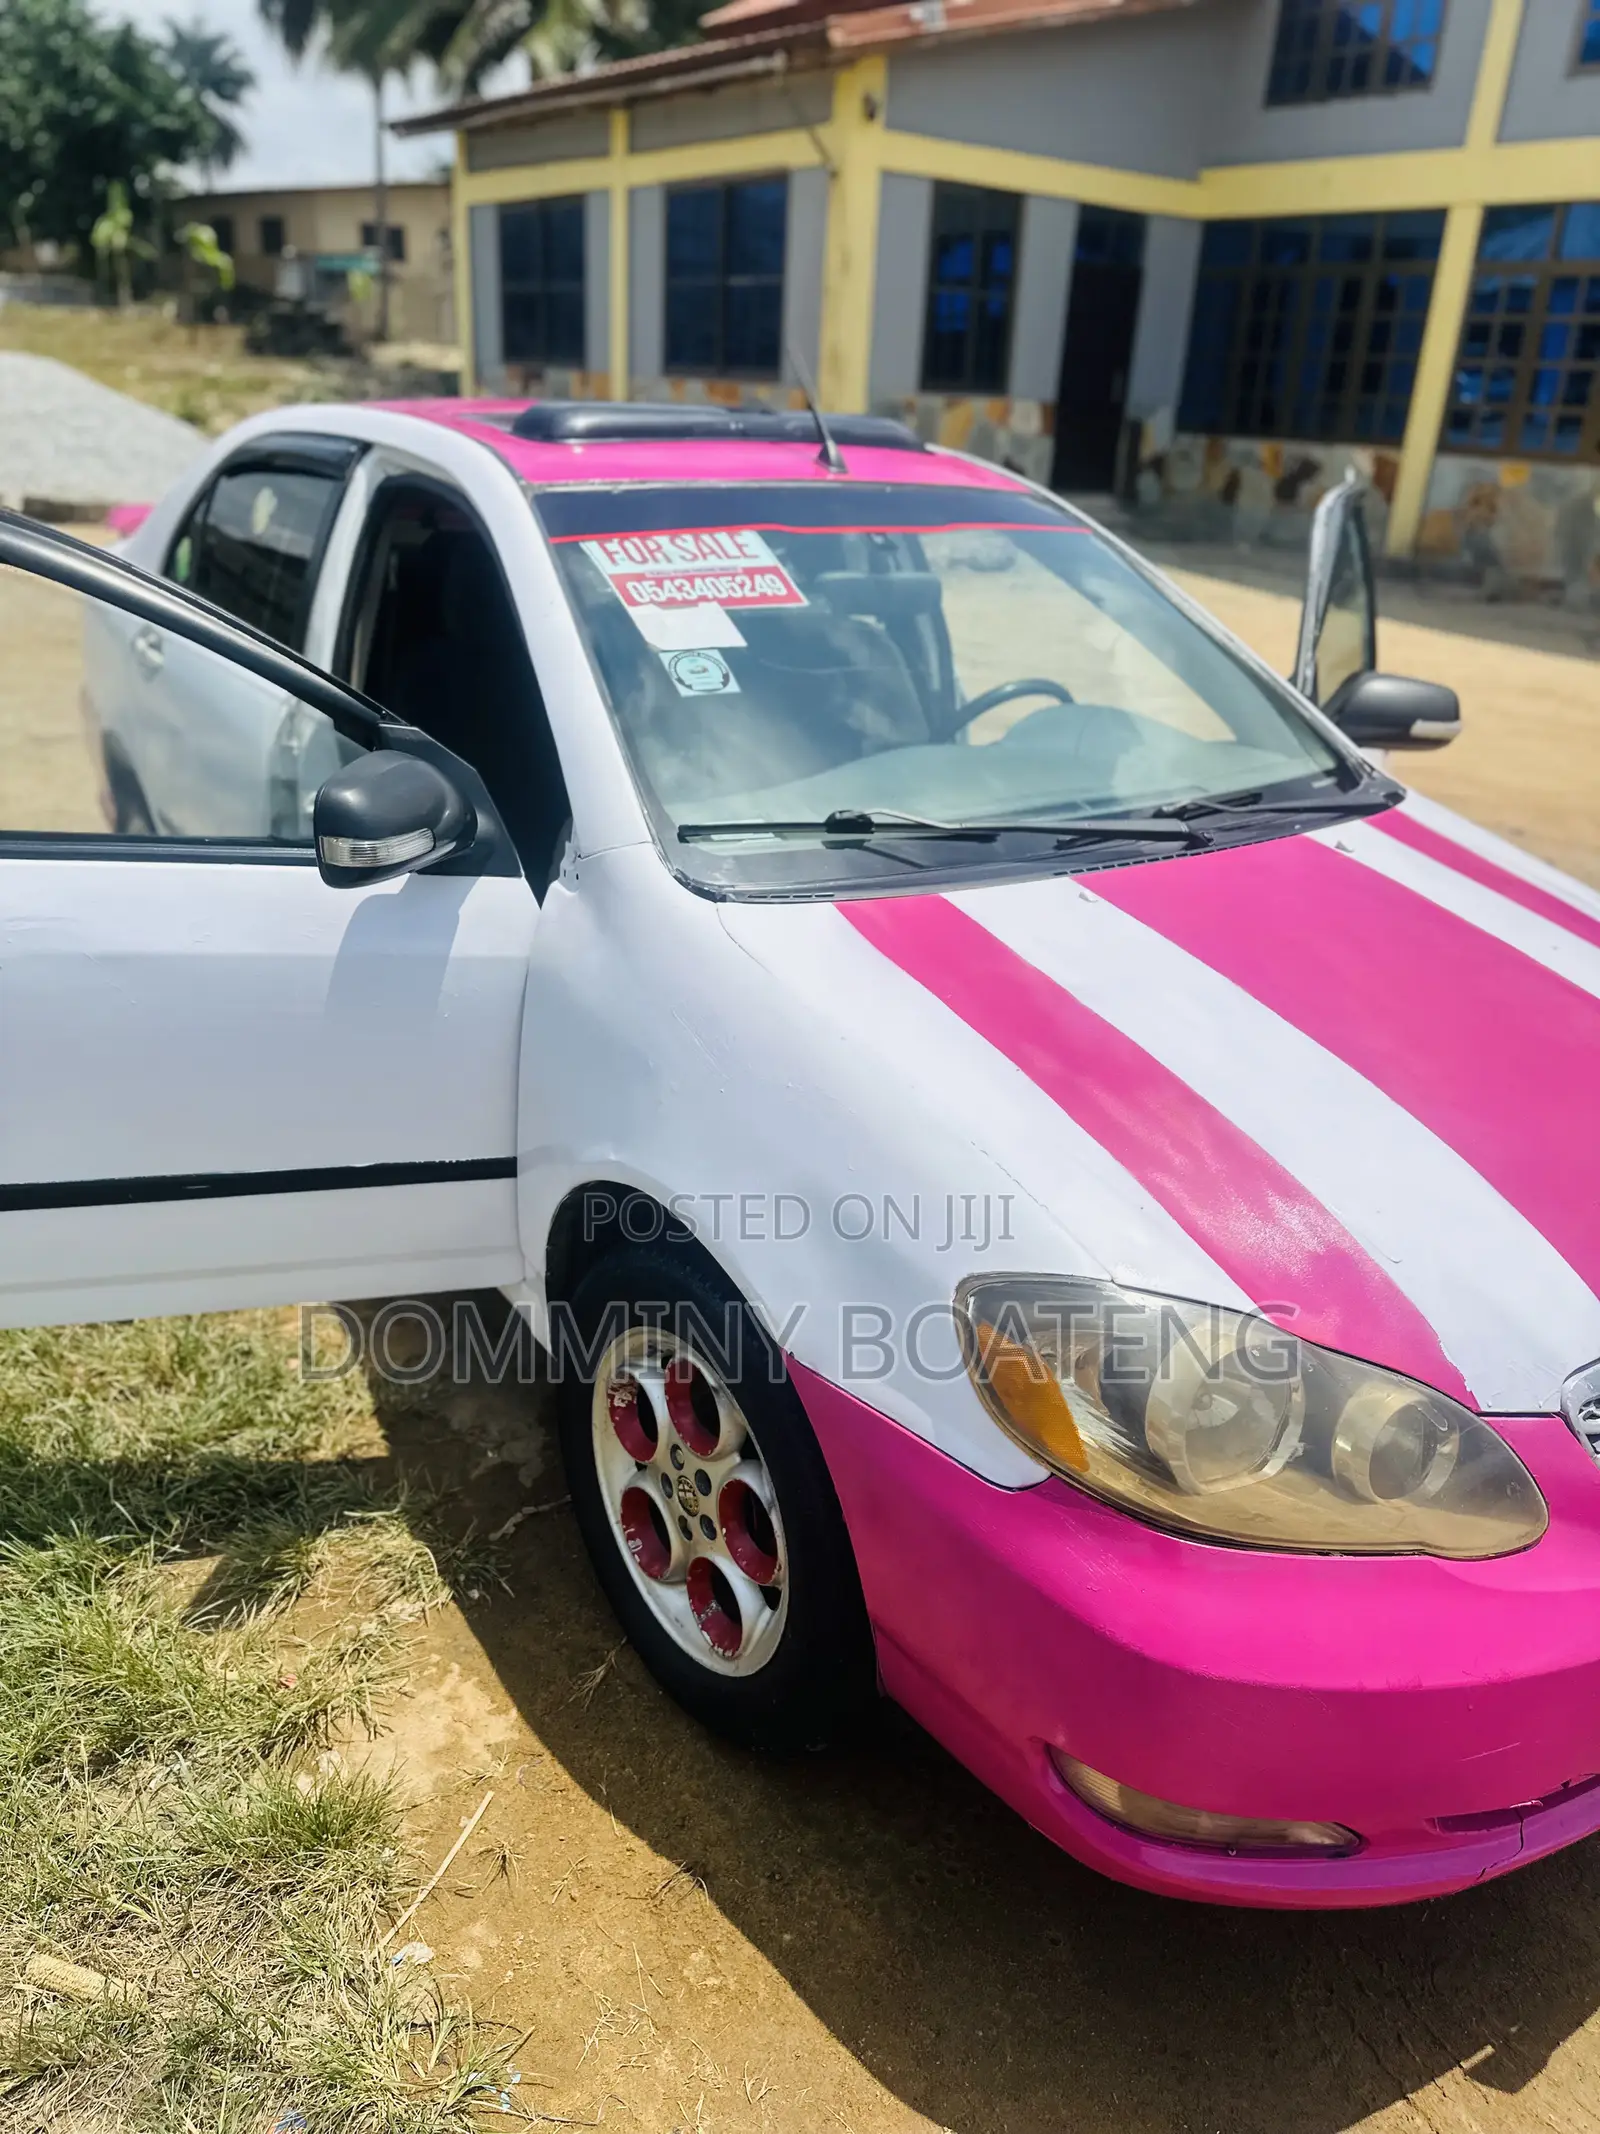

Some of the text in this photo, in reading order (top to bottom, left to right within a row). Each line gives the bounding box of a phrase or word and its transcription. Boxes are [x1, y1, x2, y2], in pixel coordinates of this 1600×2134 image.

[600, 531, 759, 567] FOR SALE
[625, 575, 788, 603] 0543405249
